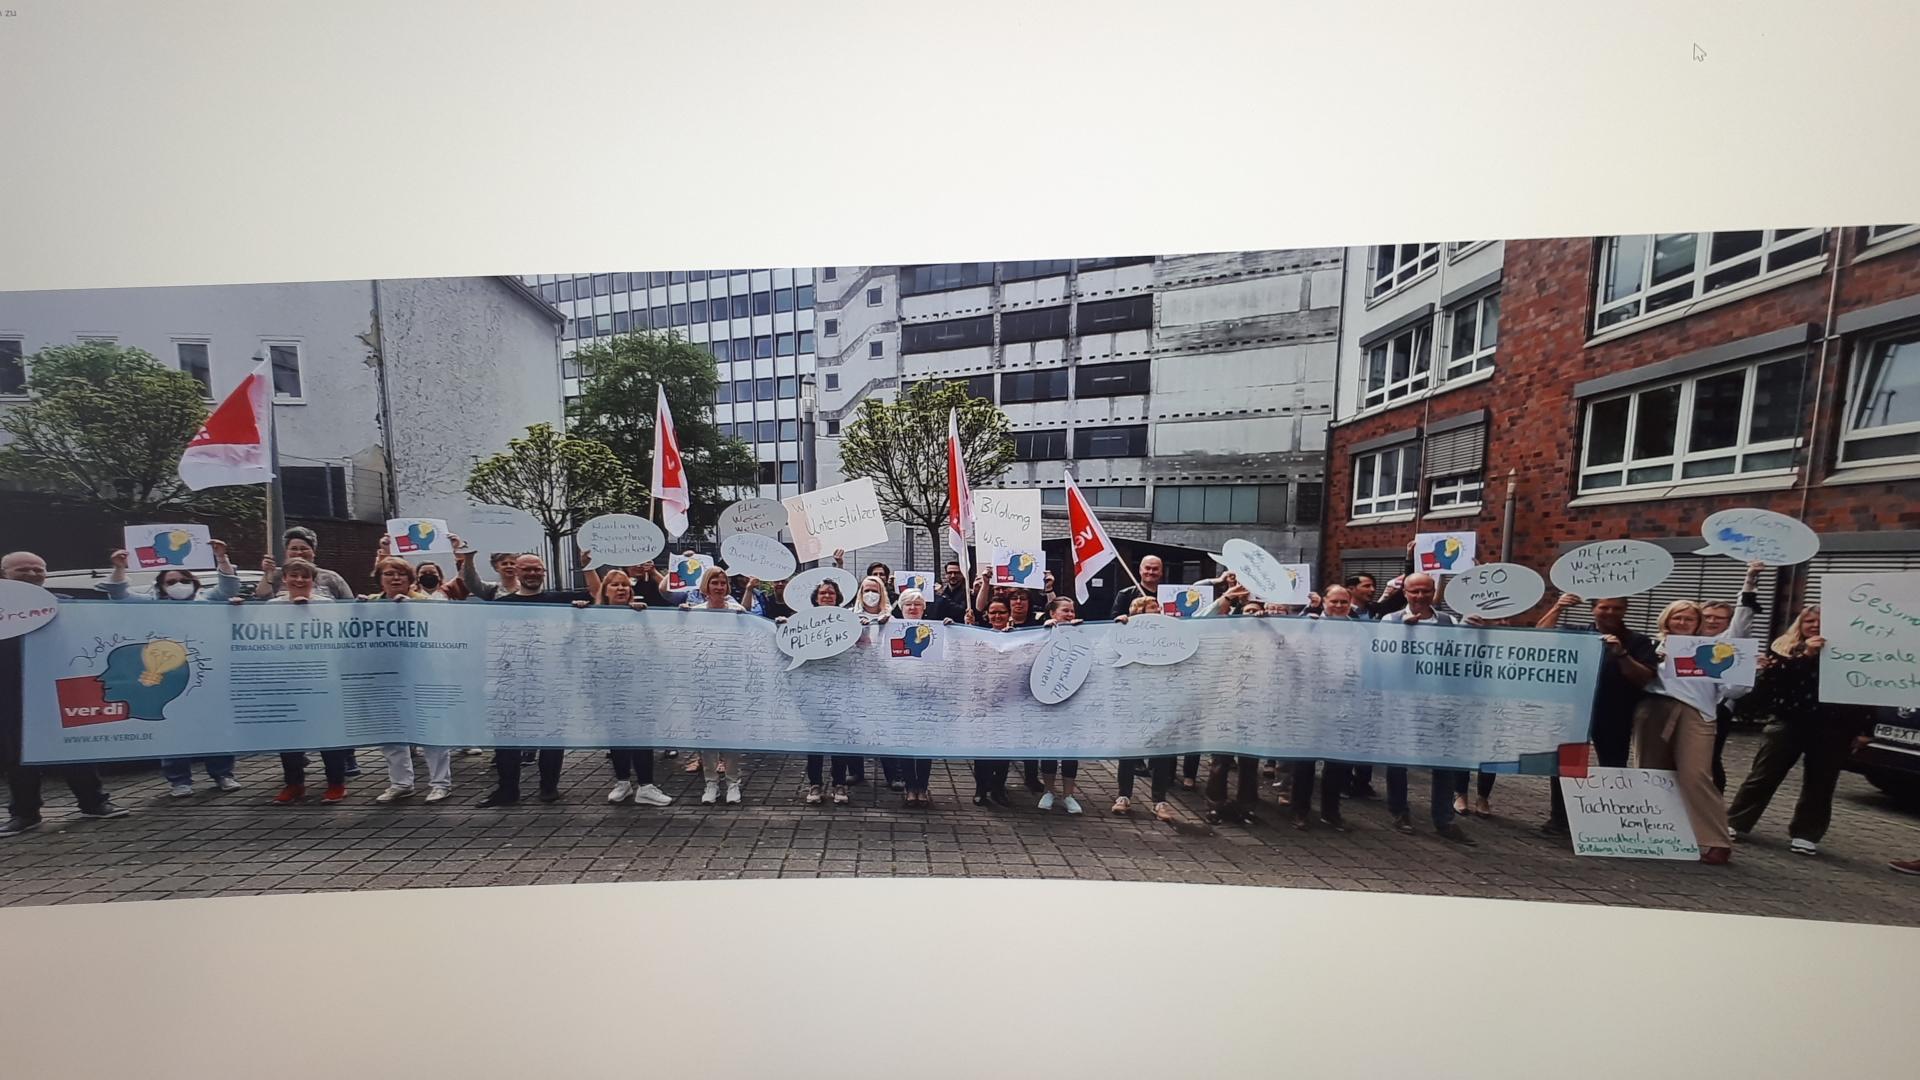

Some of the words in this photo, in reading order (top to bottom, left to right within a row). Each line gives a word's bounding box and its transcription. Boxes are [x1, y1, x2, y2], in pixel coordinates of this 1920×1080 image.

[981, 496, 1031, 532] Bildung
[1461, 576, 1472, 585] +
[1479, 569, 1507, 585] 50
[232, 623, 295, 640] KOHLE
[300, 619, 333, 639] FÜR
[338, 618, 429, 639] KÖPFCHEN
[782, 613, 846, 638] Ambulante
[1371, 639, 1397, 653] 800
[1401, 640, 1504, 660] BESCHÄFTIGTE
[1508, 646, 1579, 664] FORDERN
[1415, 660, 1460, 677] KOHLE
[1464, 661, 1492, 679] FÜR
[1497, 663, 1578, 684] KÖPFCHEN
[1876, 725, 1891, 736] HB
